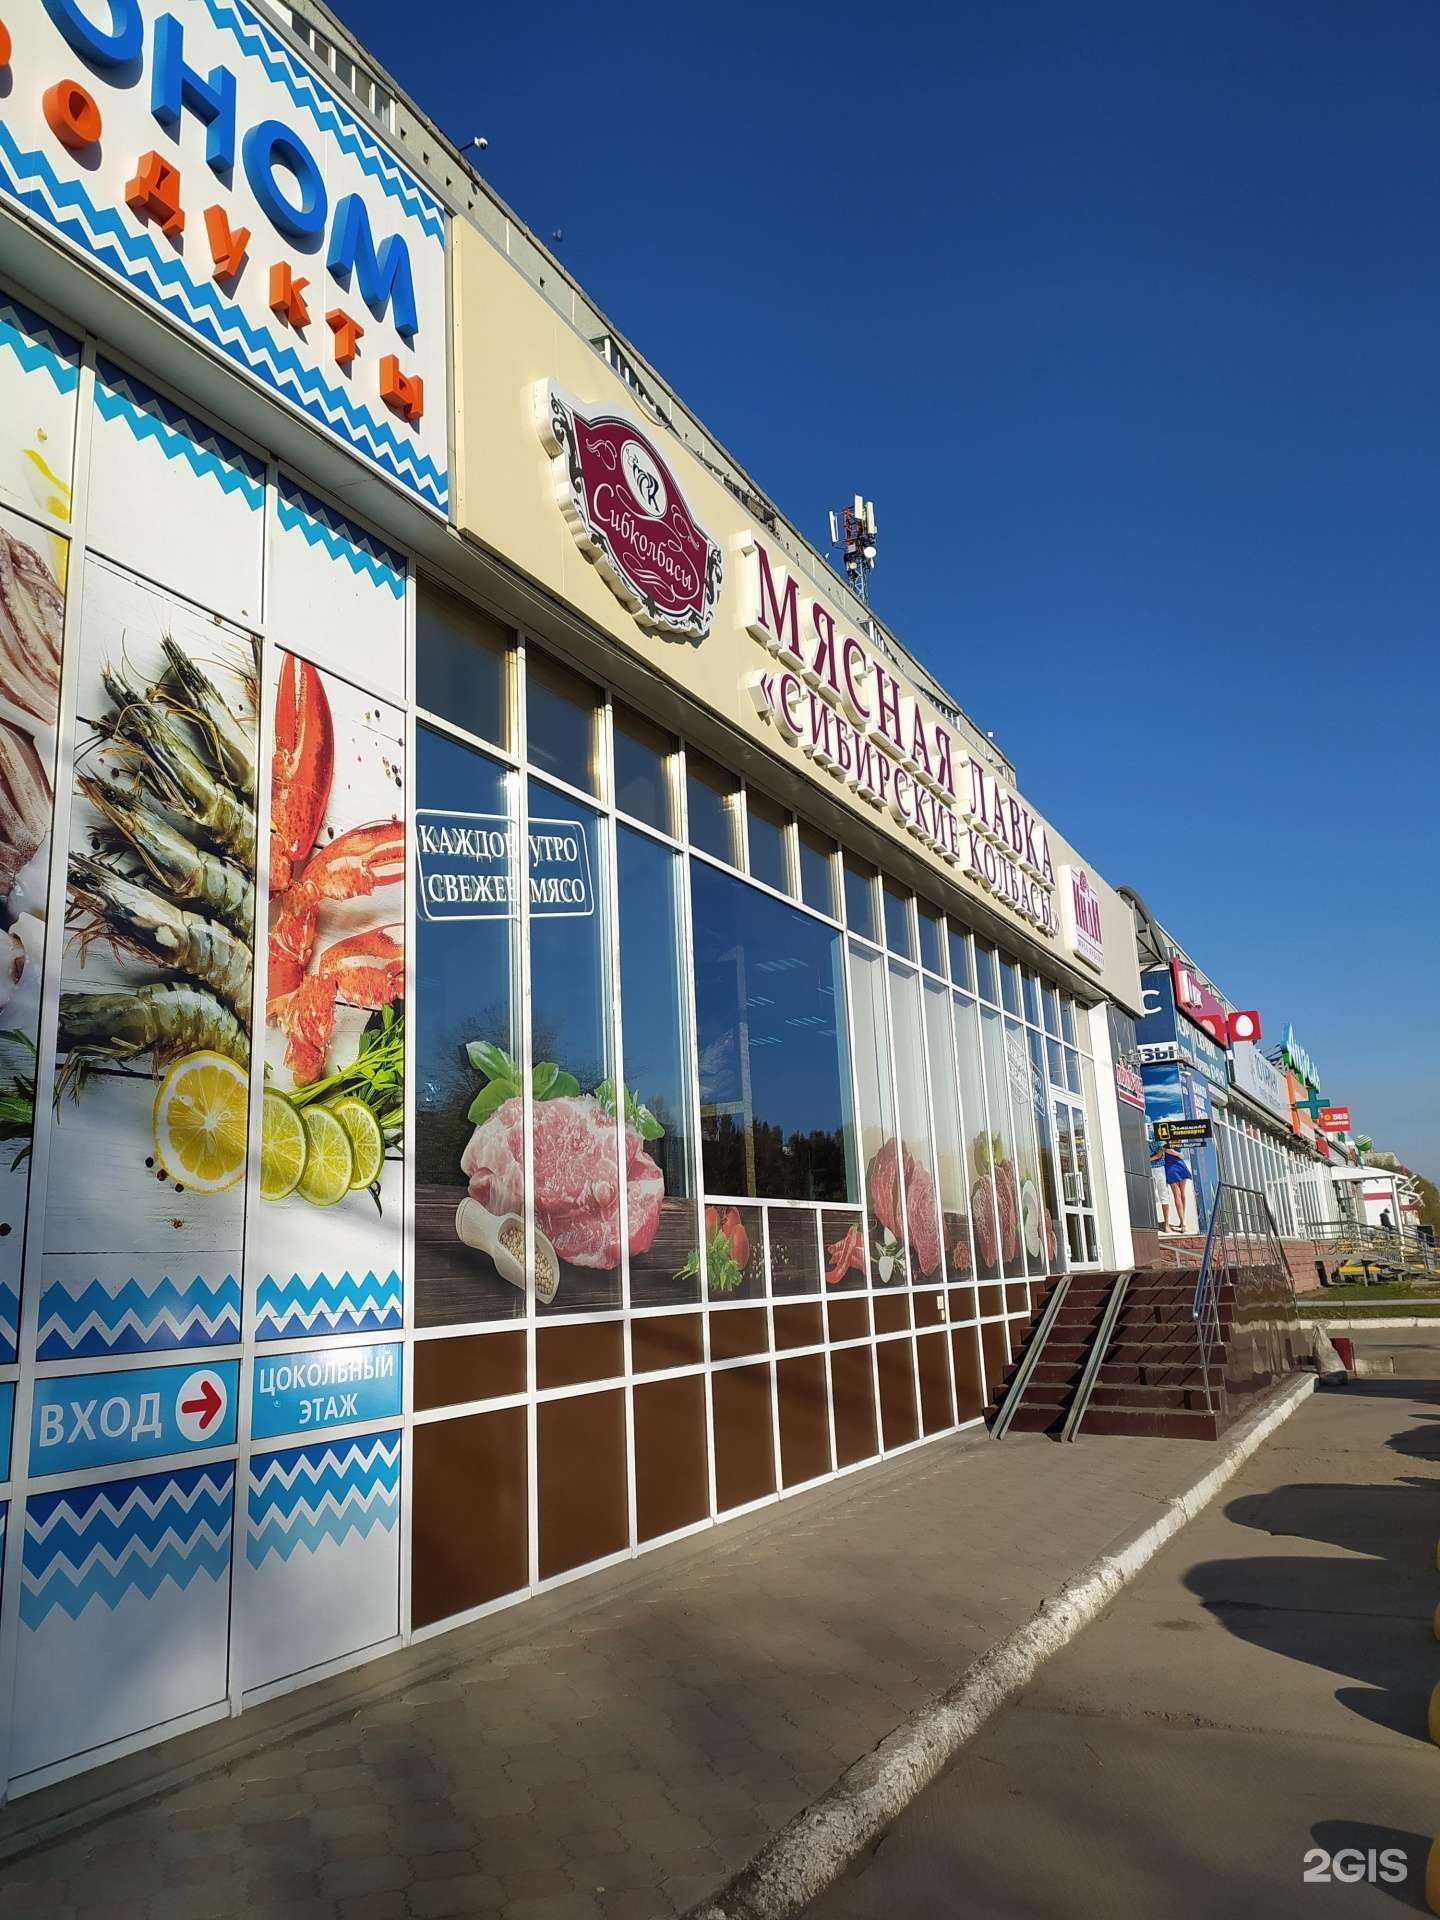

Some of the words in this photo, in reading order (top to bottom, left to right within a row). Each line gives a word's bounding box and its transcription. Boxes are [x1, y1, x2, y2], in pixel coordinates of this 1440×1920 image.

[0, 18, 423, 422] ОДУКТЫ
[593, 483, 694, 592] Сибколбасы
[753, 539, 956, 798] МЯСНАЯ
[968, 756, 1056, 887] ЛАВКА
[760, 672, 961, 862] «СИБИРСКИЕ
[528, 834, 578, 867] УТРО
[531, 877, 586, 903] МЯСО
[259, 1352, 394, 1393] ЦОКОЛЬНЫЙ
[38, 1393, 163, 1448] ВХОД
[299, 1393, 358, 1425] ЭТАЖ
